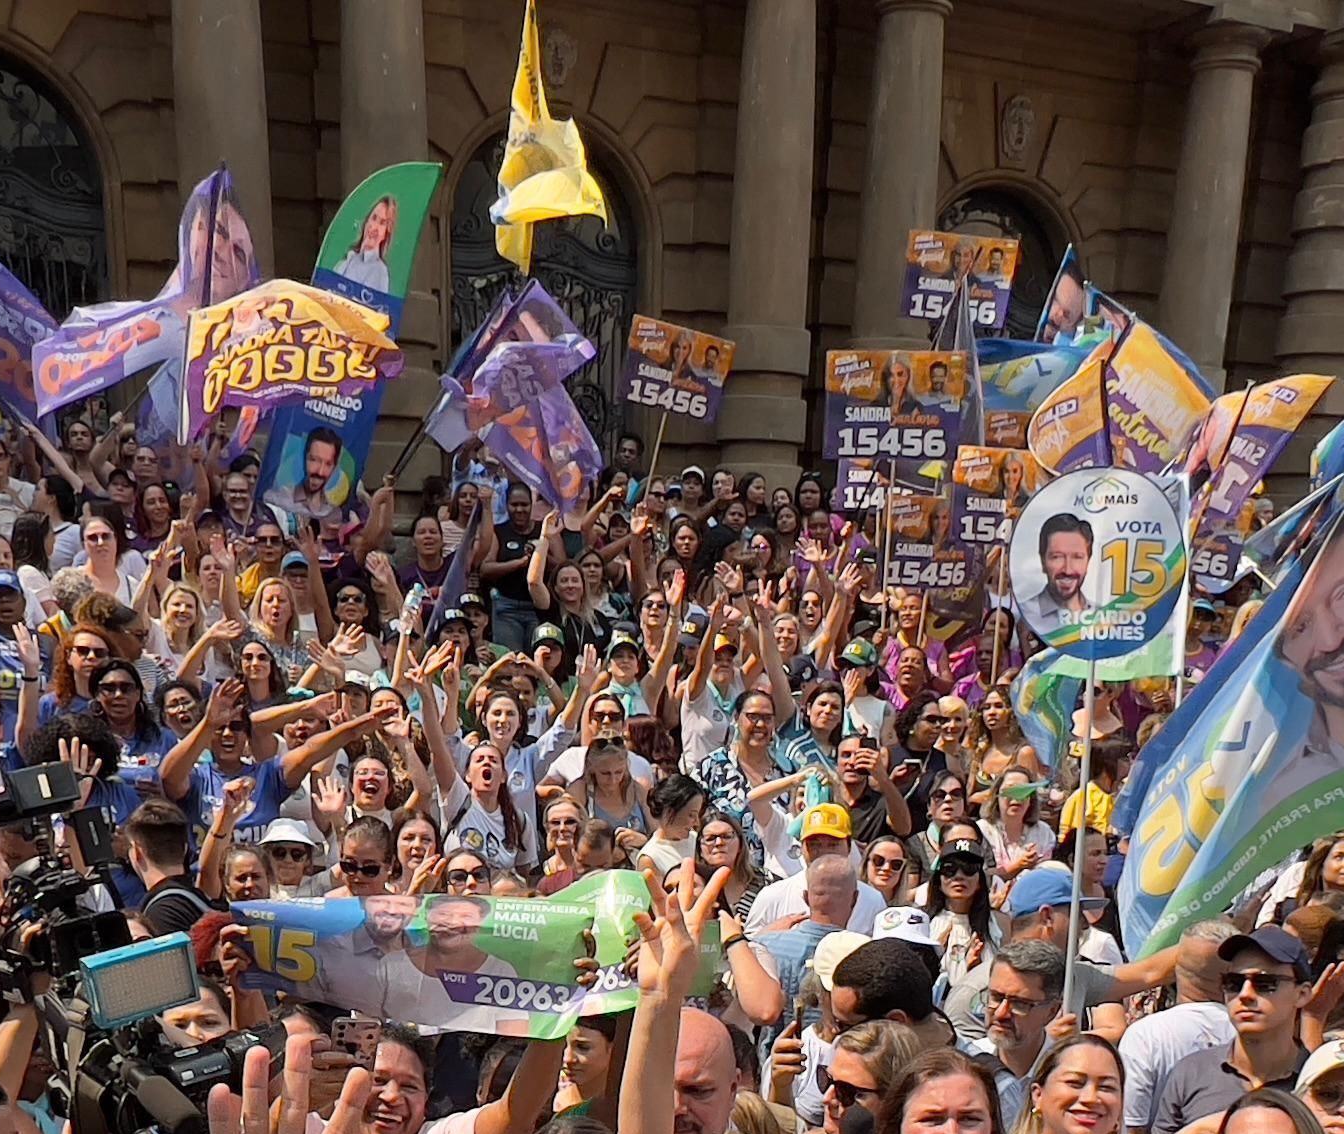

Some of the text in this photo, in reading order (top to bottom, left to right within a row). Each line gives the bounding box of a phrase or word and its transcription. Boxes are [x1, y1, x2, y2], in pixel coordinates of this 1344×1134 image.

[918, 276, 956, 293] SANDRA
[909, 293, 996, 325] 1556
[626, 379, 708, 418] 15456
[844, 406, 892, 423] SANDRA
[837, 427, 946, 457] 15456
[966, 497, 1006, 512] SANDRA
[960, 515, 1013, 543] 154
[1116, 521, 1163, 534] VOTA
[895, 543, 934, 557] SANDRA
[887, 560, 966, 587] 15456
[1100, 538, 1168, 598] 15
[1057, 608, 1148, 627] RICARDO
[1080, 626, 1146, 642] NUNES
[243, 907, 276, 921] VOTE
[493, 900, 591, 916] ENFERMEIRA
[493, 911, 547, 926] MARIA
[249, 926, 318, 984] 15
[443, 972, 468, 985] VOTE
[474, 975, 570, 1012] 20963
